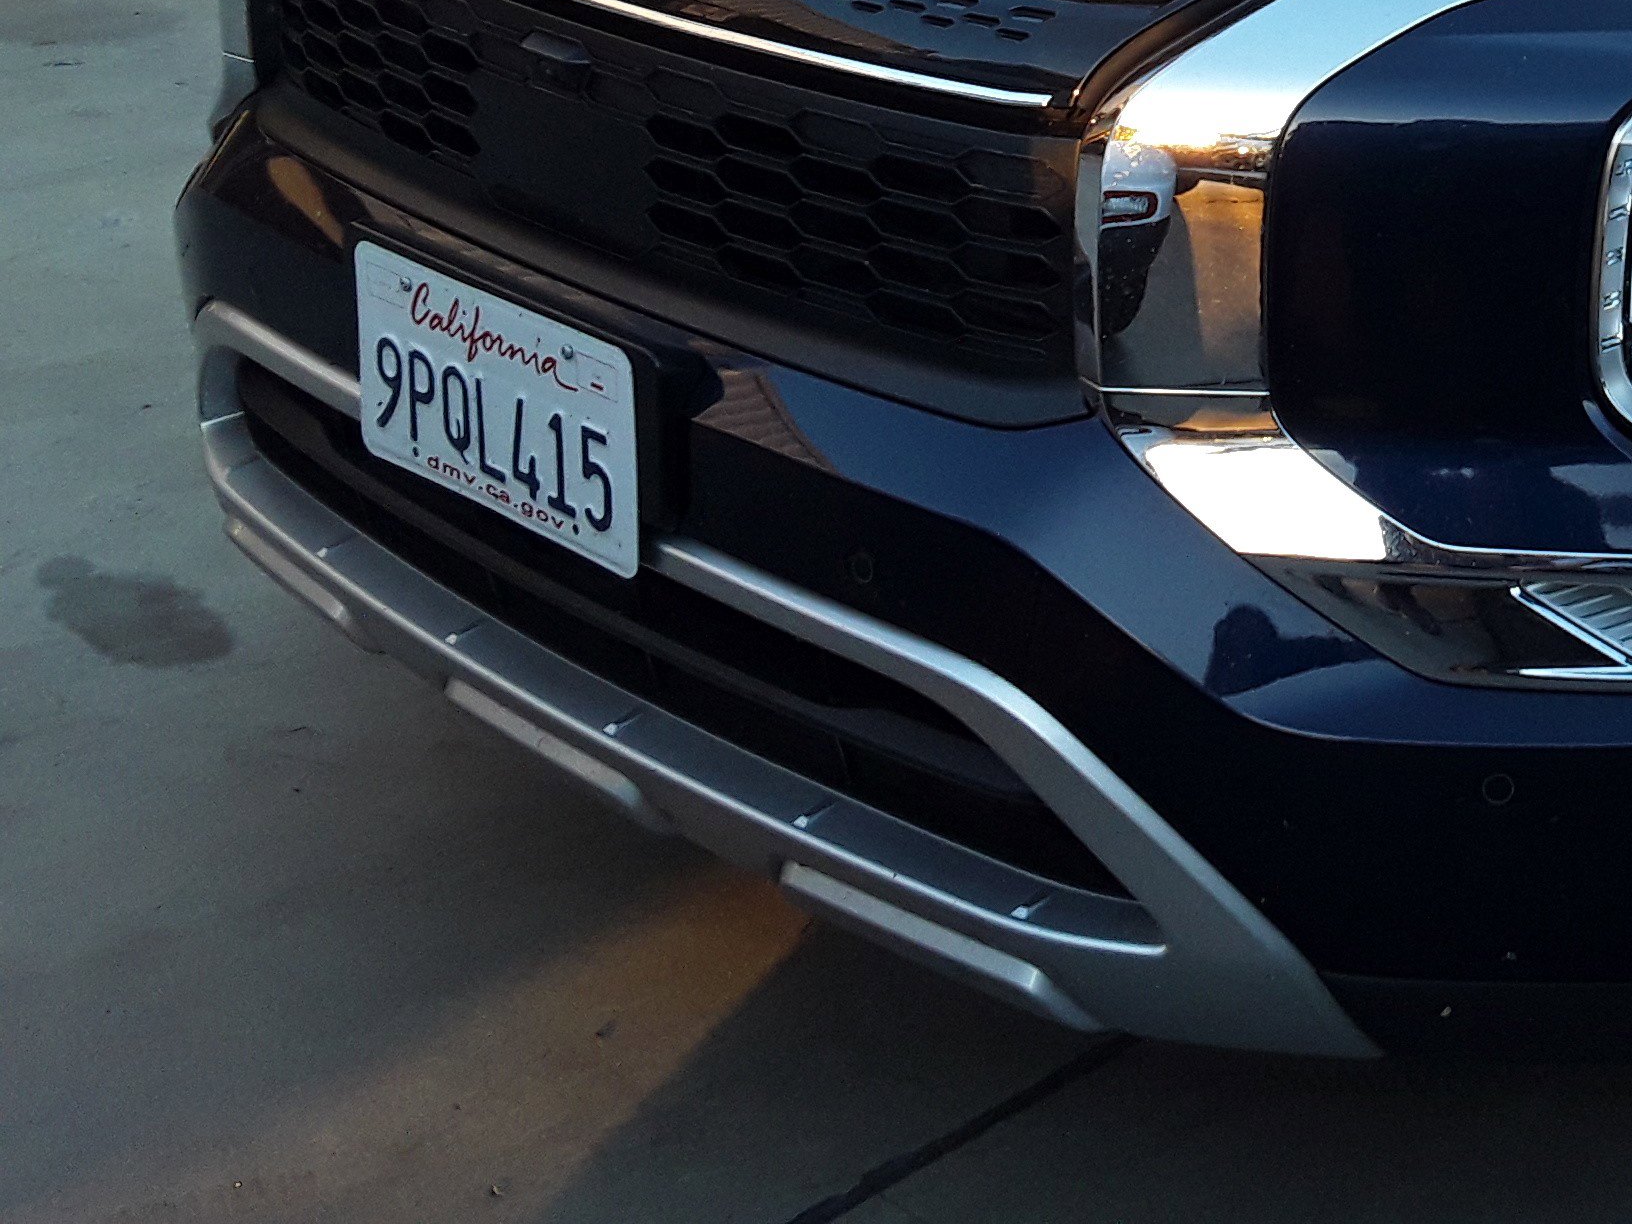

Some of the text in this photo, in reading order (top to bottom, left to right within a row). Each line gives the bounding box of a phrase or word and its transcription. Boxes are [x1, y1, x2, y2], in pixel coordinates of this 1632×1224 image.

[410, 282, 579, 392] California
[376, 336, 614, 532] 9PQL415
[426, 455, 566, 532] dmv.ca.gov
